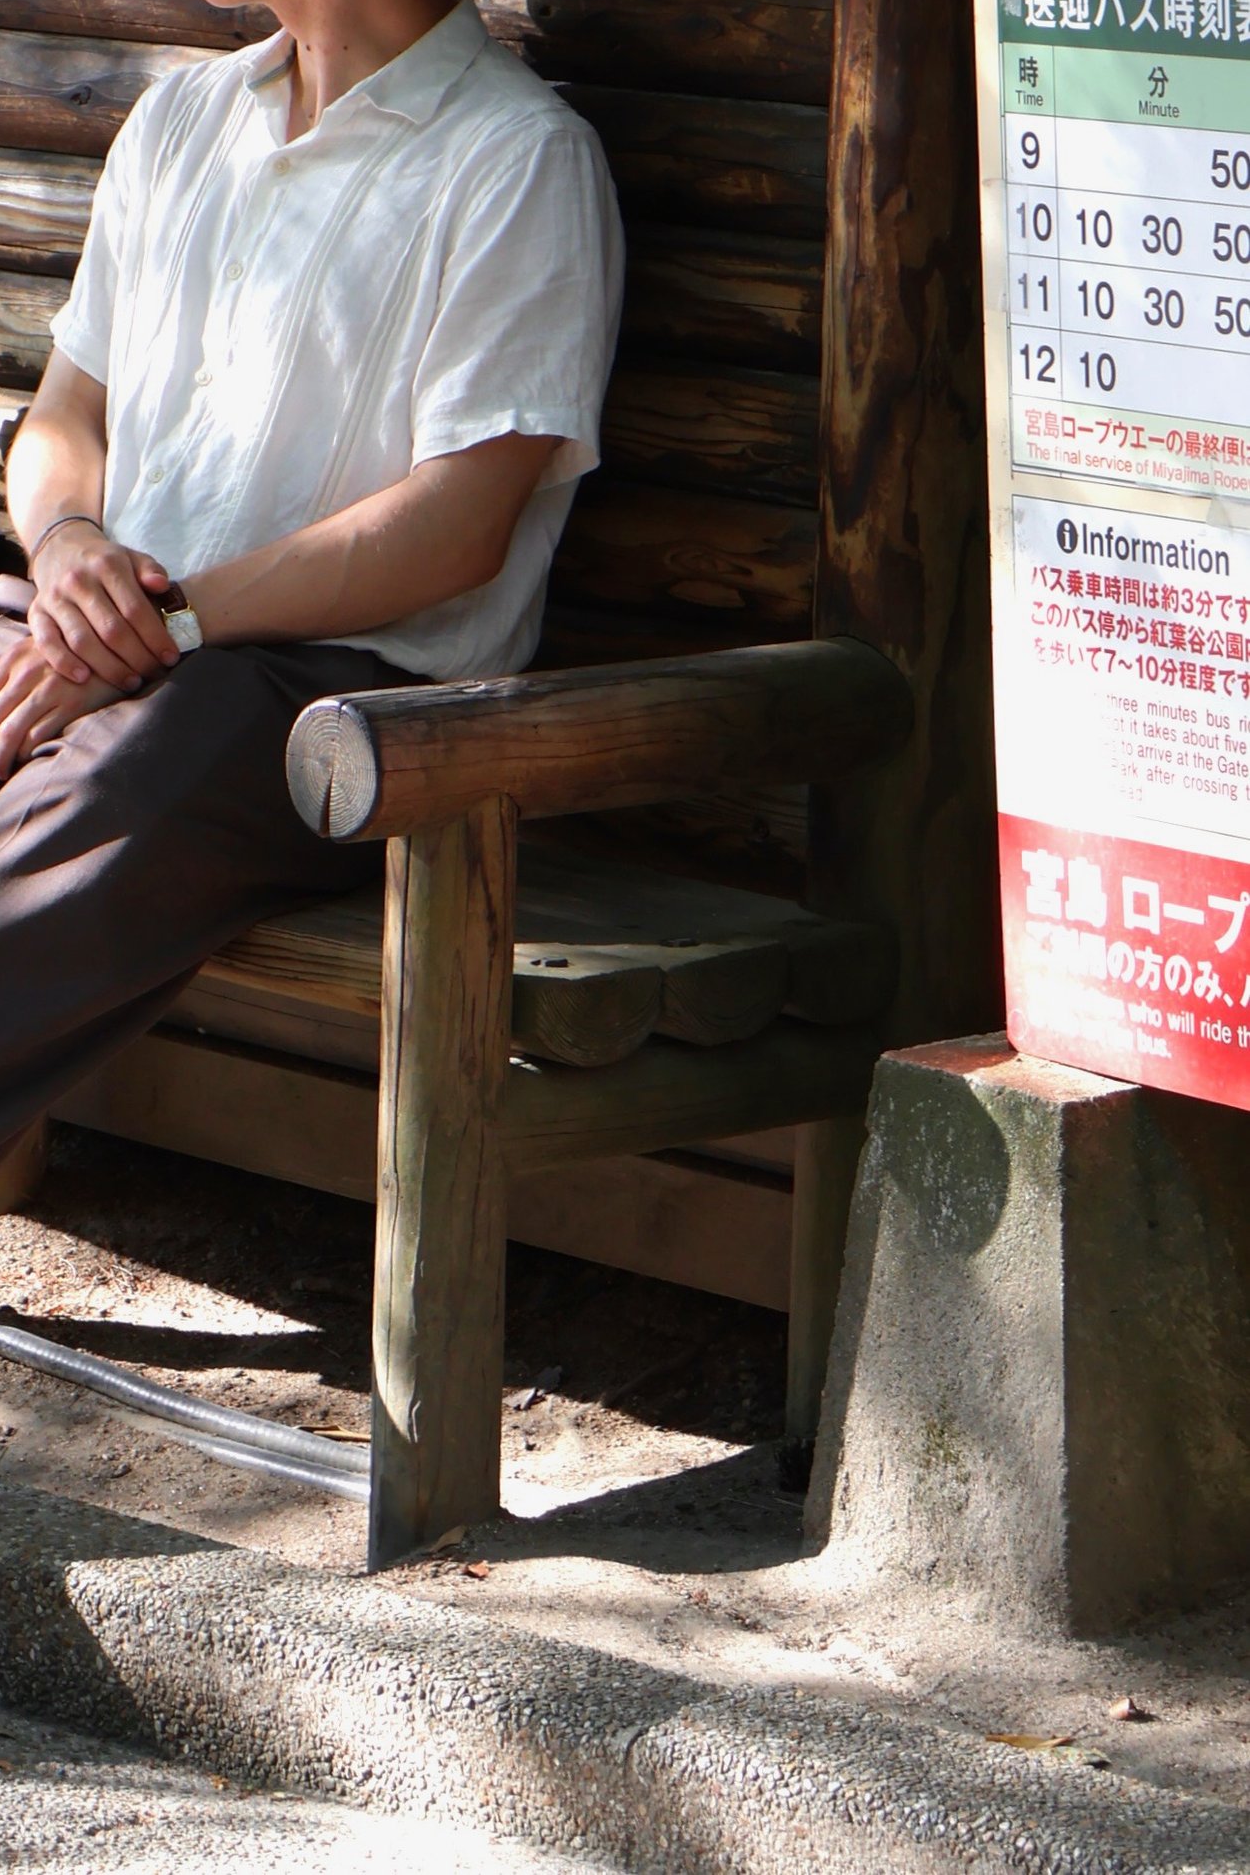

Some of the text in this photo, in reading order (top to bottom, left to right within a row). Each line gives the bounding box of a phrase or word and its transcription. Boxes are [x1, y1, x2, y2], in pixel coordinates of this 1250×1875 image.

[1018, 57, 1169, 98] 時 分
[1015, 89, 1180, 118] Time Minute
[1021, 132, 1250, 190] 9 50
[1016, 202, 1250, 264] 10 10 30 50
[1018, 272, 1250, 337] 11 10 30 50
[1019, 344, 1116, 391] 12 10
[1027, 442, 1050, 461] The
[1054, 446, 1081, 465] final
[1086, 455, 1132, 473] service
[1136, 461, 1149, 475] of
[1153, 462, 1209, 485] Miyajima
[1082, 523, 1229, 575] Information
[1148, 700, 1197, 723] minutes
[1206, 709, 1230, 729] bus
[1130, 719, 1137, 735] it
[1143, 721, 1176, 742] takes
[1183, 728, 1219, 750] about
[1225, 734, 1246, 755] five
[1138, 744, 1172, 763] arrive
[1177, 751, 1189, 766] at
[1193, 753, 1212, 771] the
[1218, 756, 1248, 777] Gate
[1147, 766, 1237, 801] after crossing
[1128, 1002, 1162, 1027] who
[1167, 1010, 1194, 1035] will
[1201, 1017, 1232, 1044] ride
[1137, 1032, 1172, 1058] bus.
